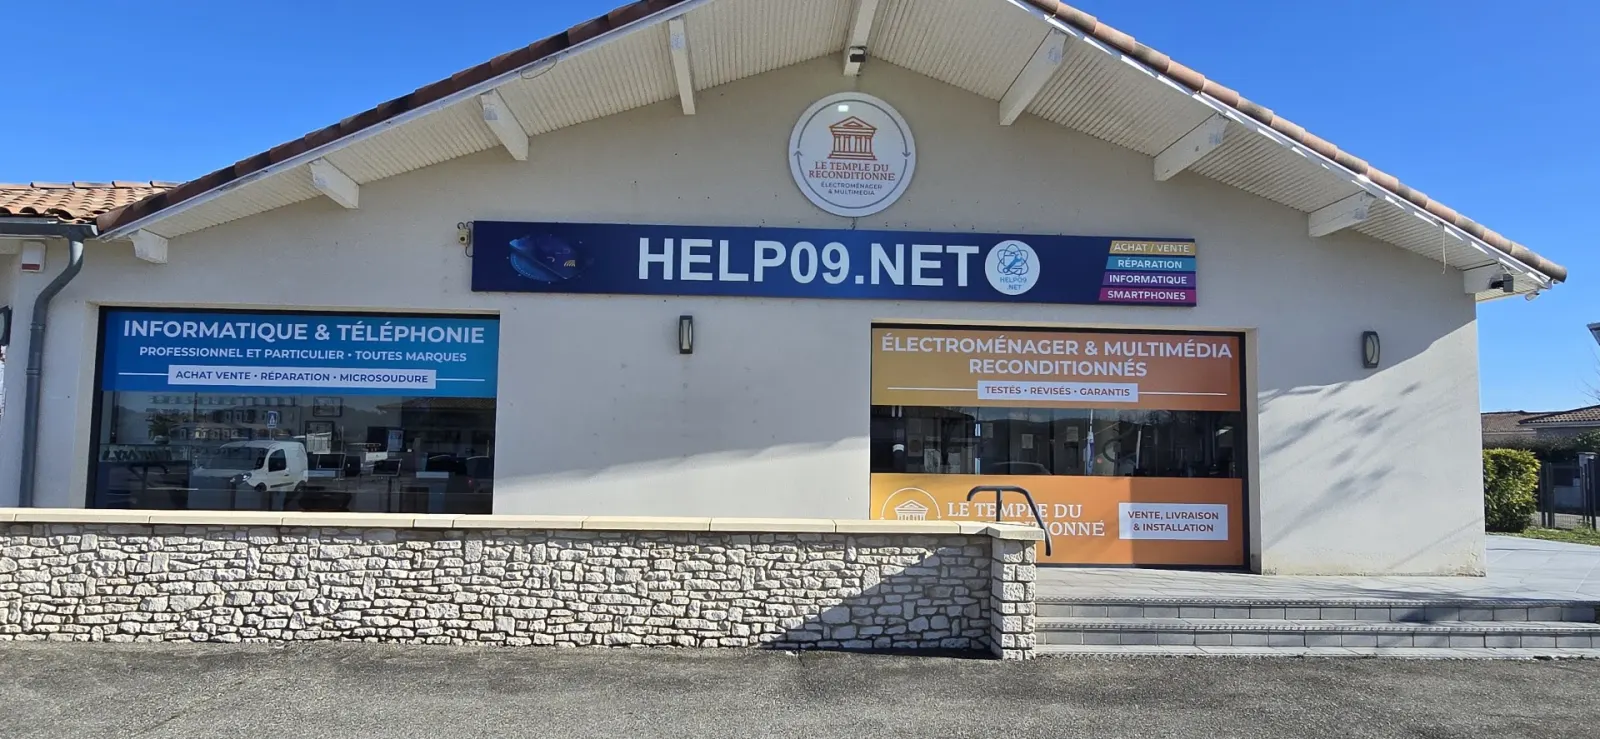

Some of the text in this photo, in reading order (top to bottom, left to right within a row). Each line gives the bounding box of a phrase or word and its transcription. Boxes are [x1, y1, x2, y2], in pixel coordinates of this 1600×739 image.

[815, 161, 889, 173] LE TEMPLE DU
[1114, 243, 1148, 252] ACHAT
[1156, 244, 1190, 253] VENTE
[638, 237, 980, 287] HELP09.NET
[1118, 257, 1182, 269] RÉPARATION
[1109, 274, 1187, 285] INFORMATIQUE
[1107, 290, 1186, 300] SMARTPHONES
[123, 320, 485, 344] INFORMATIQUE & TÉLÉPHONIE
[881, 333, 1233, 359] ÉLECTROMÉNAGER & MULTIMÉDIA
[139, 346, 467, 363] PROFESSIONNEL ET PARTICULIER TOUTES MARQUES
[969, 357, 1147, 377] RECONDITIONNÉS
[175, 370, 429, 383] ACHAT VENTE RÉPARATION MICROSOUDURE
[985, 384, 1022, 394] TESTÉS
[1079, 387, 1131, 397] GARANTIS
[947, 502, 970, 517] LE
[1054, 504, 1083, 518] DU
[1128, 511, 1219, 520] VENTE, LIVRAISON
[1133, 523, 1214, 532] & INSTALLATION
